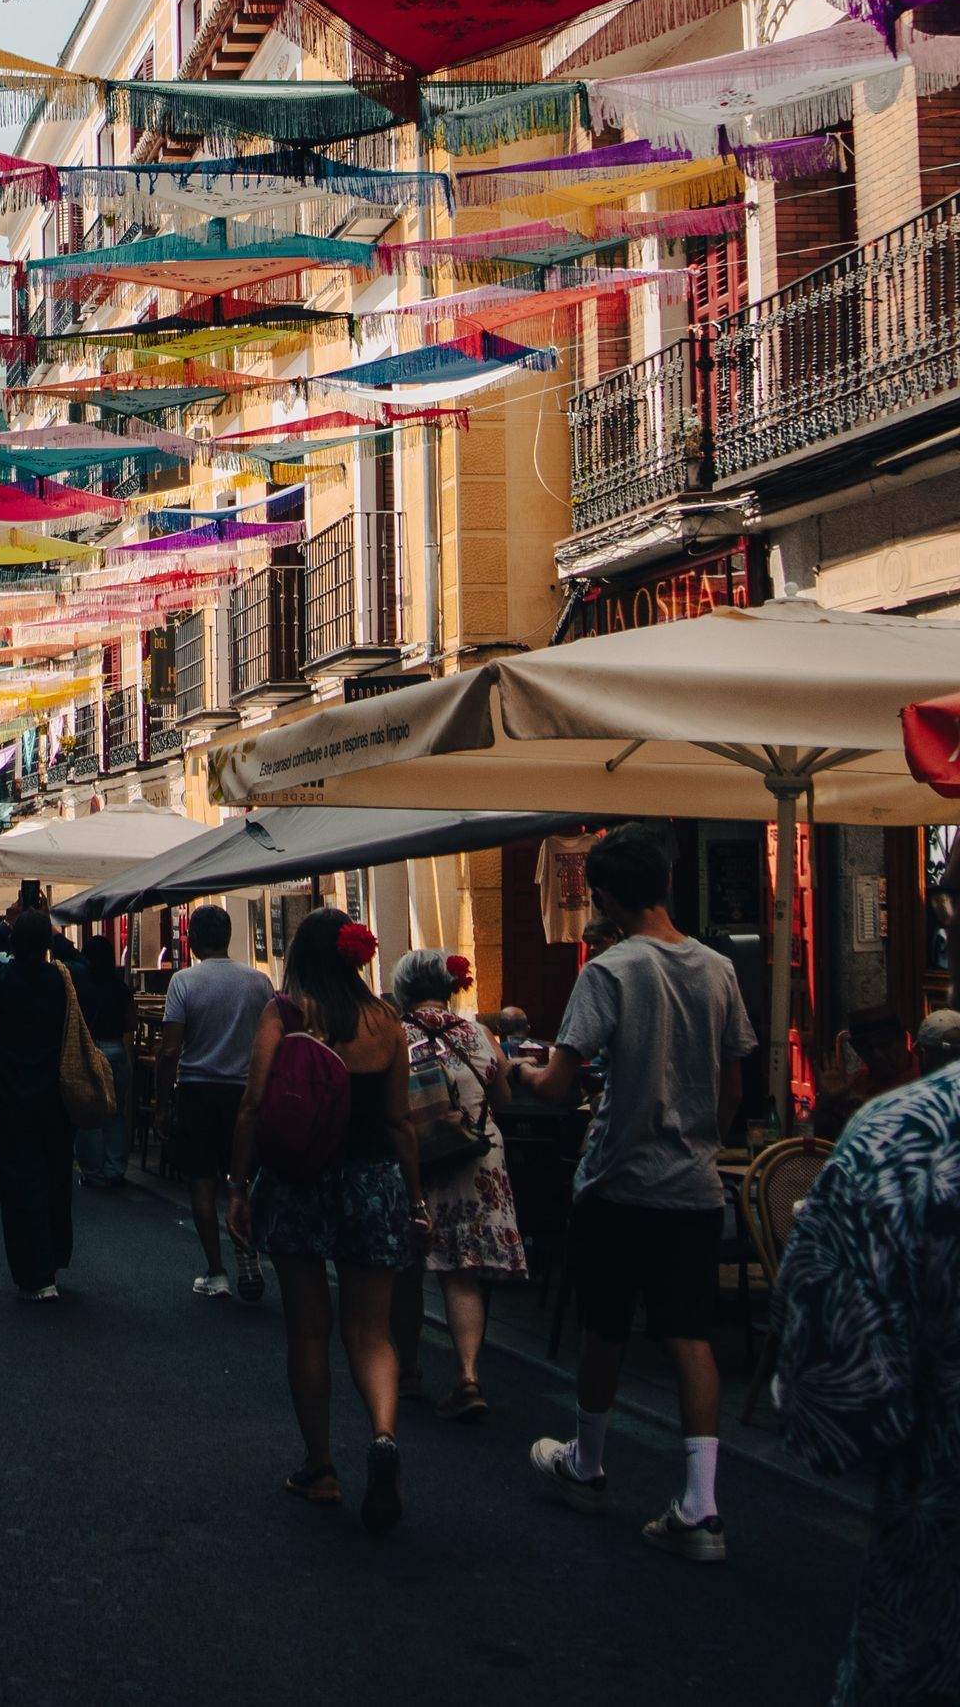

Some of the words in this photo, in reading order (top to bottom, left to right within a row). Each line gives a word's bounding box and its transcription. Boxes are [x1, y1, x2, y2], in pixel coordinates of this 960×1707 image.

[154, 637, 168, 649] DEL
[259, 762, 273, 777] Este
[324, 745, 329, 758] a
[329, 741, 341, 760] que
[342, 732, 369, 755] respires
[370, 726, 385, 746] más
[386, 721, 410, 744] limpio
